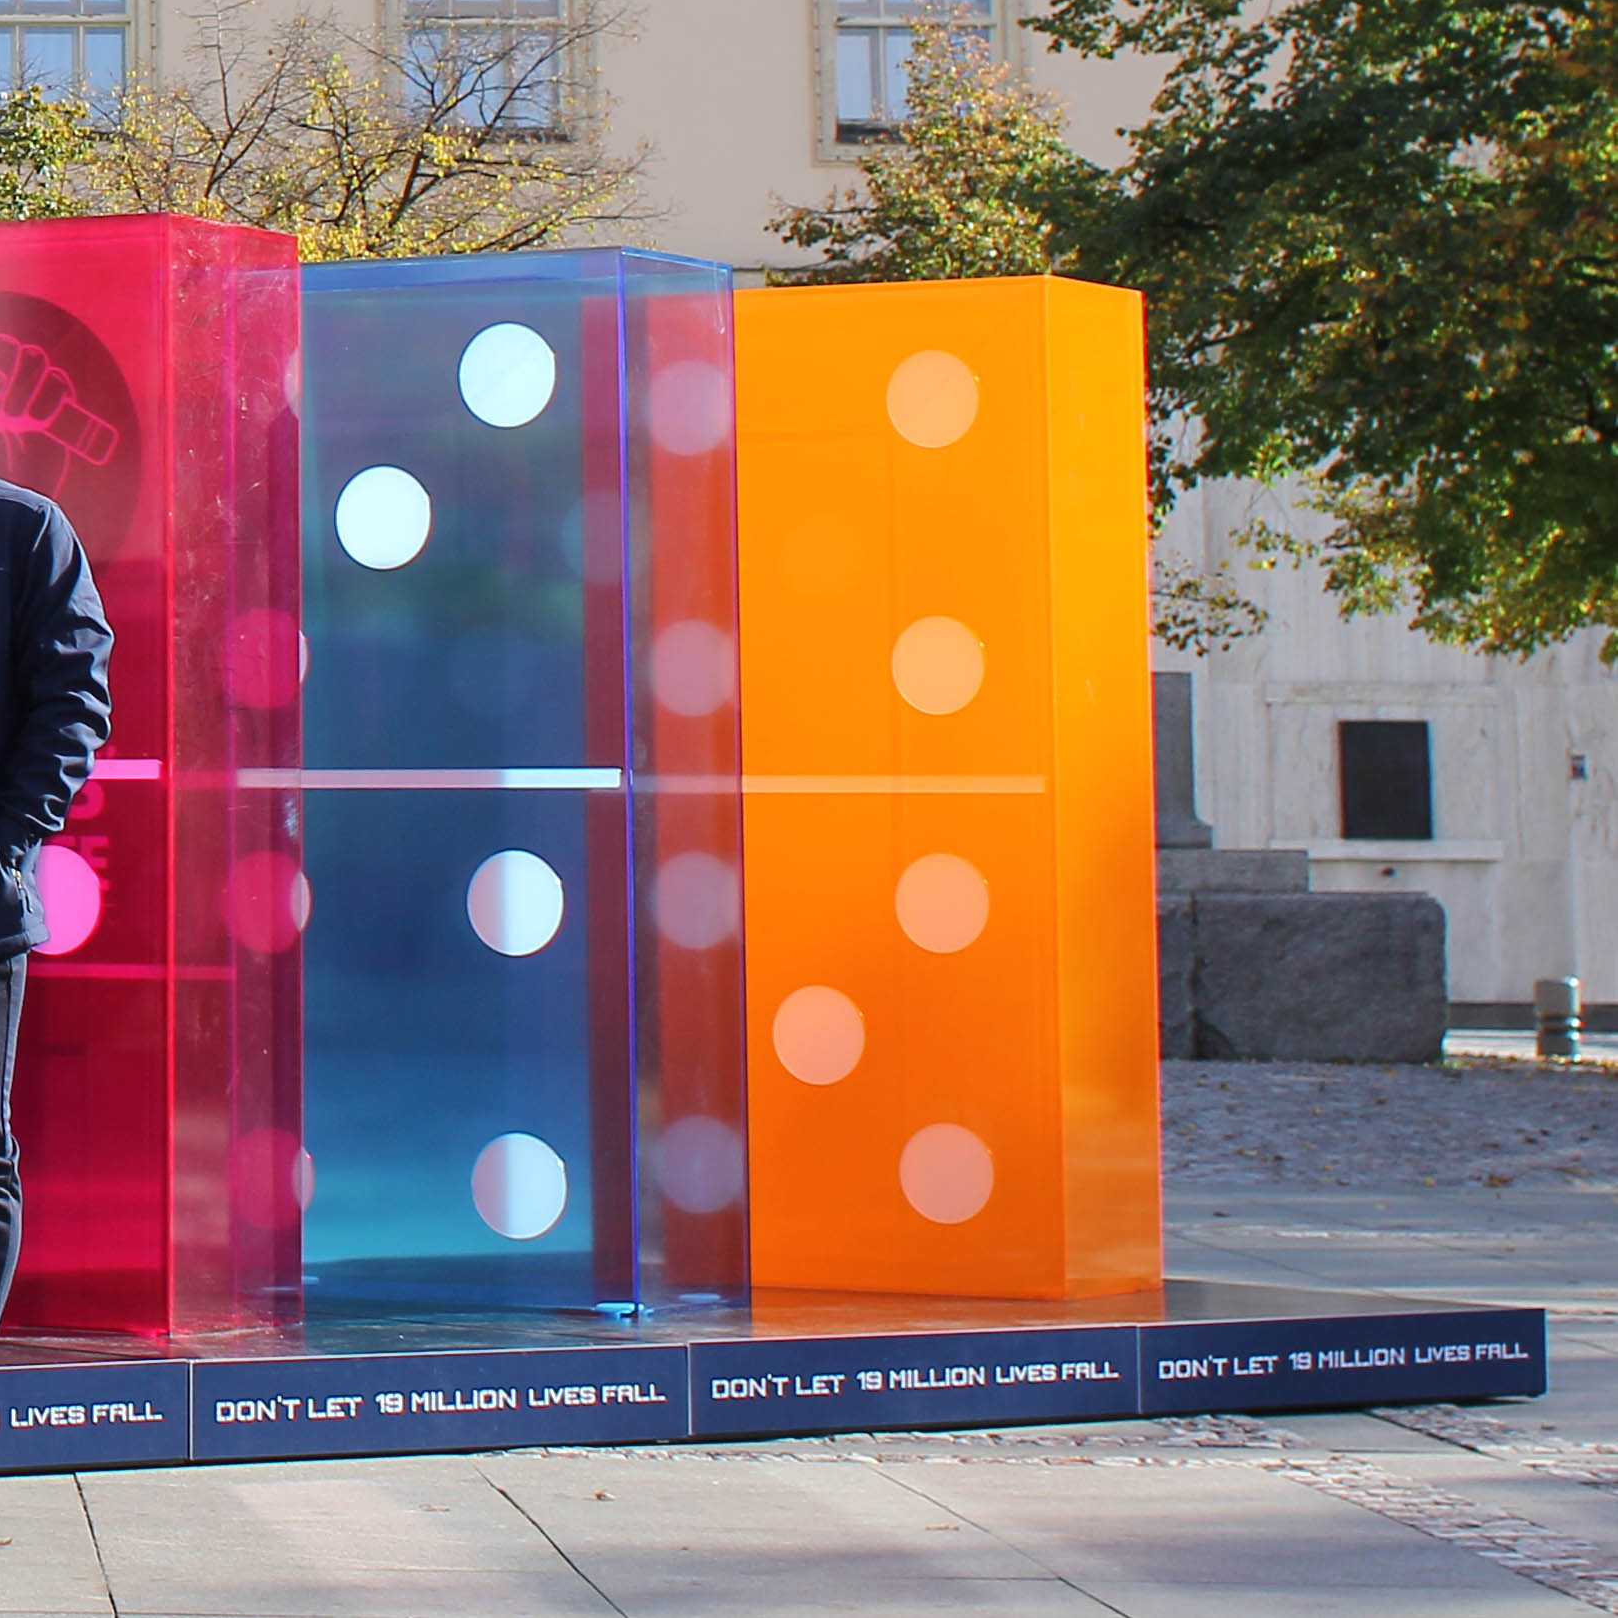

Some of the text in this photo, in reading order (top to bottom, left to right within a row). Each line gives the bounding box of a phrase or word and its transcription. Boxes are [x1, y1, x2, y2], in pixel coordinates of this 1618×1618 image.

[711, 1361, 1119, 1399] DON'T LET 19 MILLION LIVES FALL
[1158, 1342, 1528, 1380] DON'T LET 19 MILLION LIVES FALL
[10, 1406, 86, 1427] LIVES
[92, 1402, 163, 1423] FALL
[215, 1383, 666, 1422] DON'T LET 19 MILLION LIVES FALL
